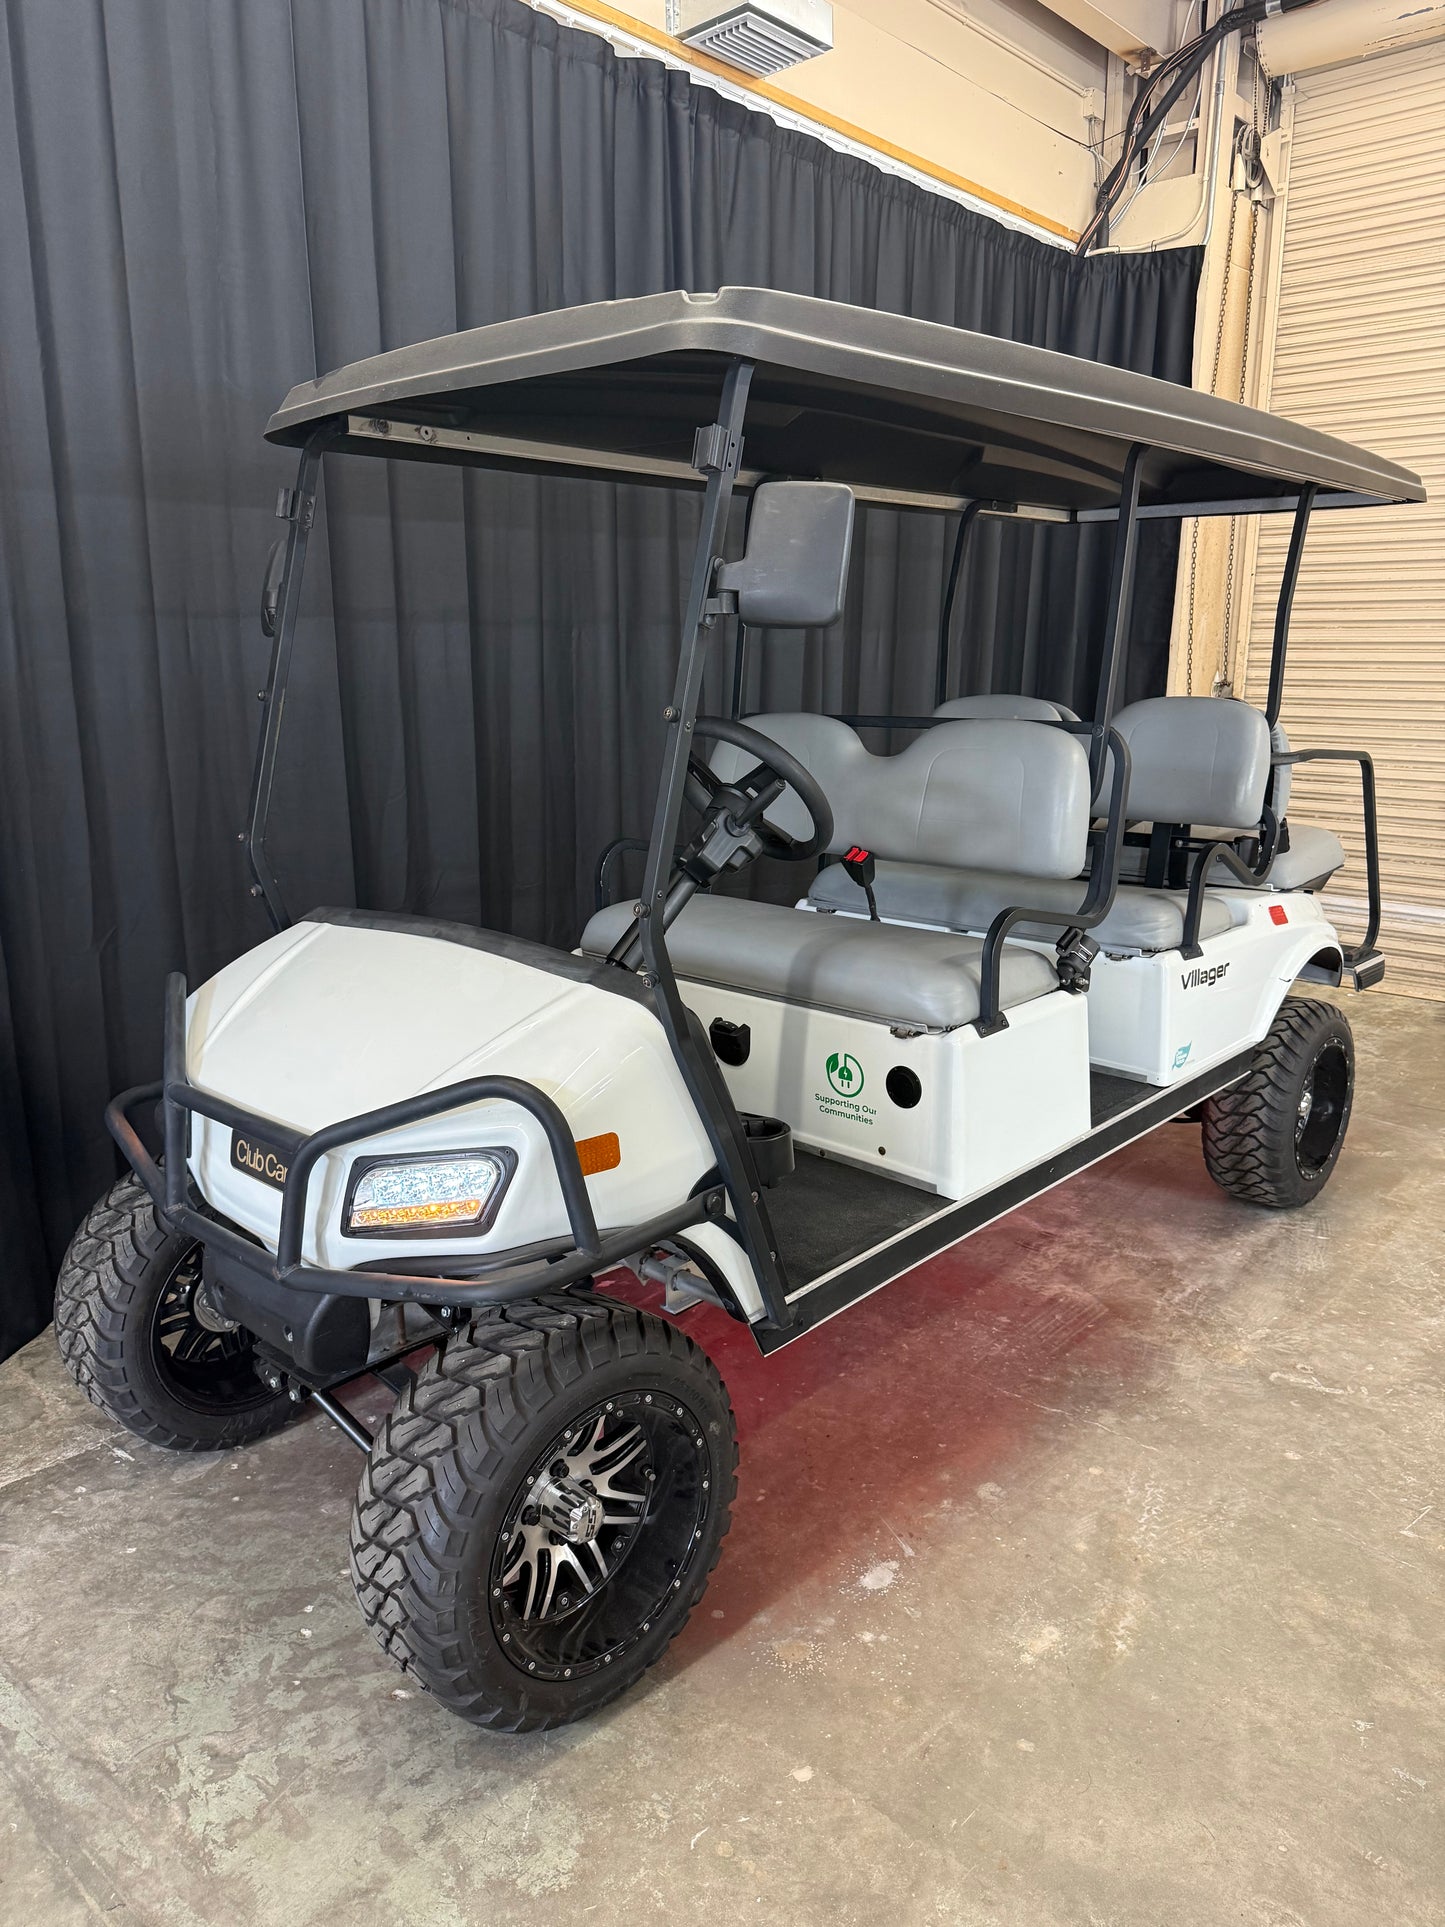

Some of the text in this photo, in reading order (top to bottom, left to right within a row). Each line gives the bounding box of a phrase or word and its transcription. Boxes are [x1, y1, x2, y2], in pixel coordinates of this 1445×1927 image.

[1181, 962, 1230, 990] Villager
[814, 1093, 877, 1115] Supporting Our
[819, 1105, 873, 1125] Communities
[236, 1139, 289, 1183] Club Car
